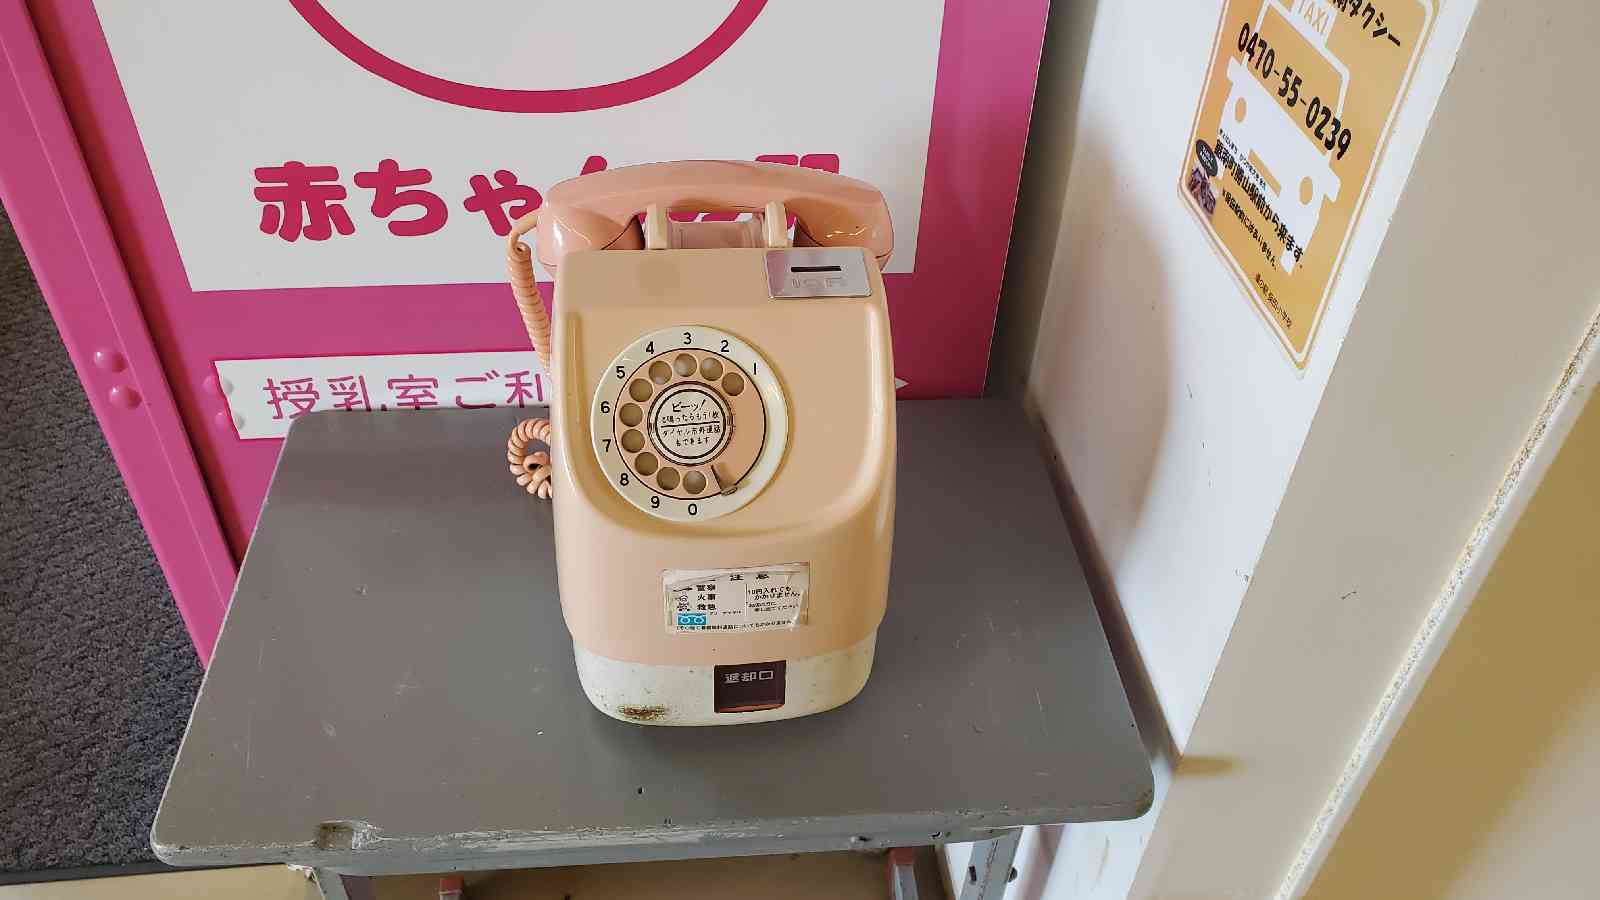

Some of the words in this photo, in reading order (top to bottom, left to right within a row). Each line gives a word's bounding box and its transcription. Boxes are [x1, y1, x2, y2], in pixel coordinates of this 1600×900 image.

[1237, 22, 1352, 161] 0470-55-0239
[683, 332, 692, 345] 3
[645, 341, 655, 355] 4
[720, 340, 729, 353] 2
[616, 365, 626, 380] 5
[600, 401, 611, 414] 6
[602, 439, 612, 453] 7
[619, 472, 630, 487] 8
[650, 495, 661, 509] 9
[687, 503, 698, 516] 0
[723, 670, 774, 684] 返却口
